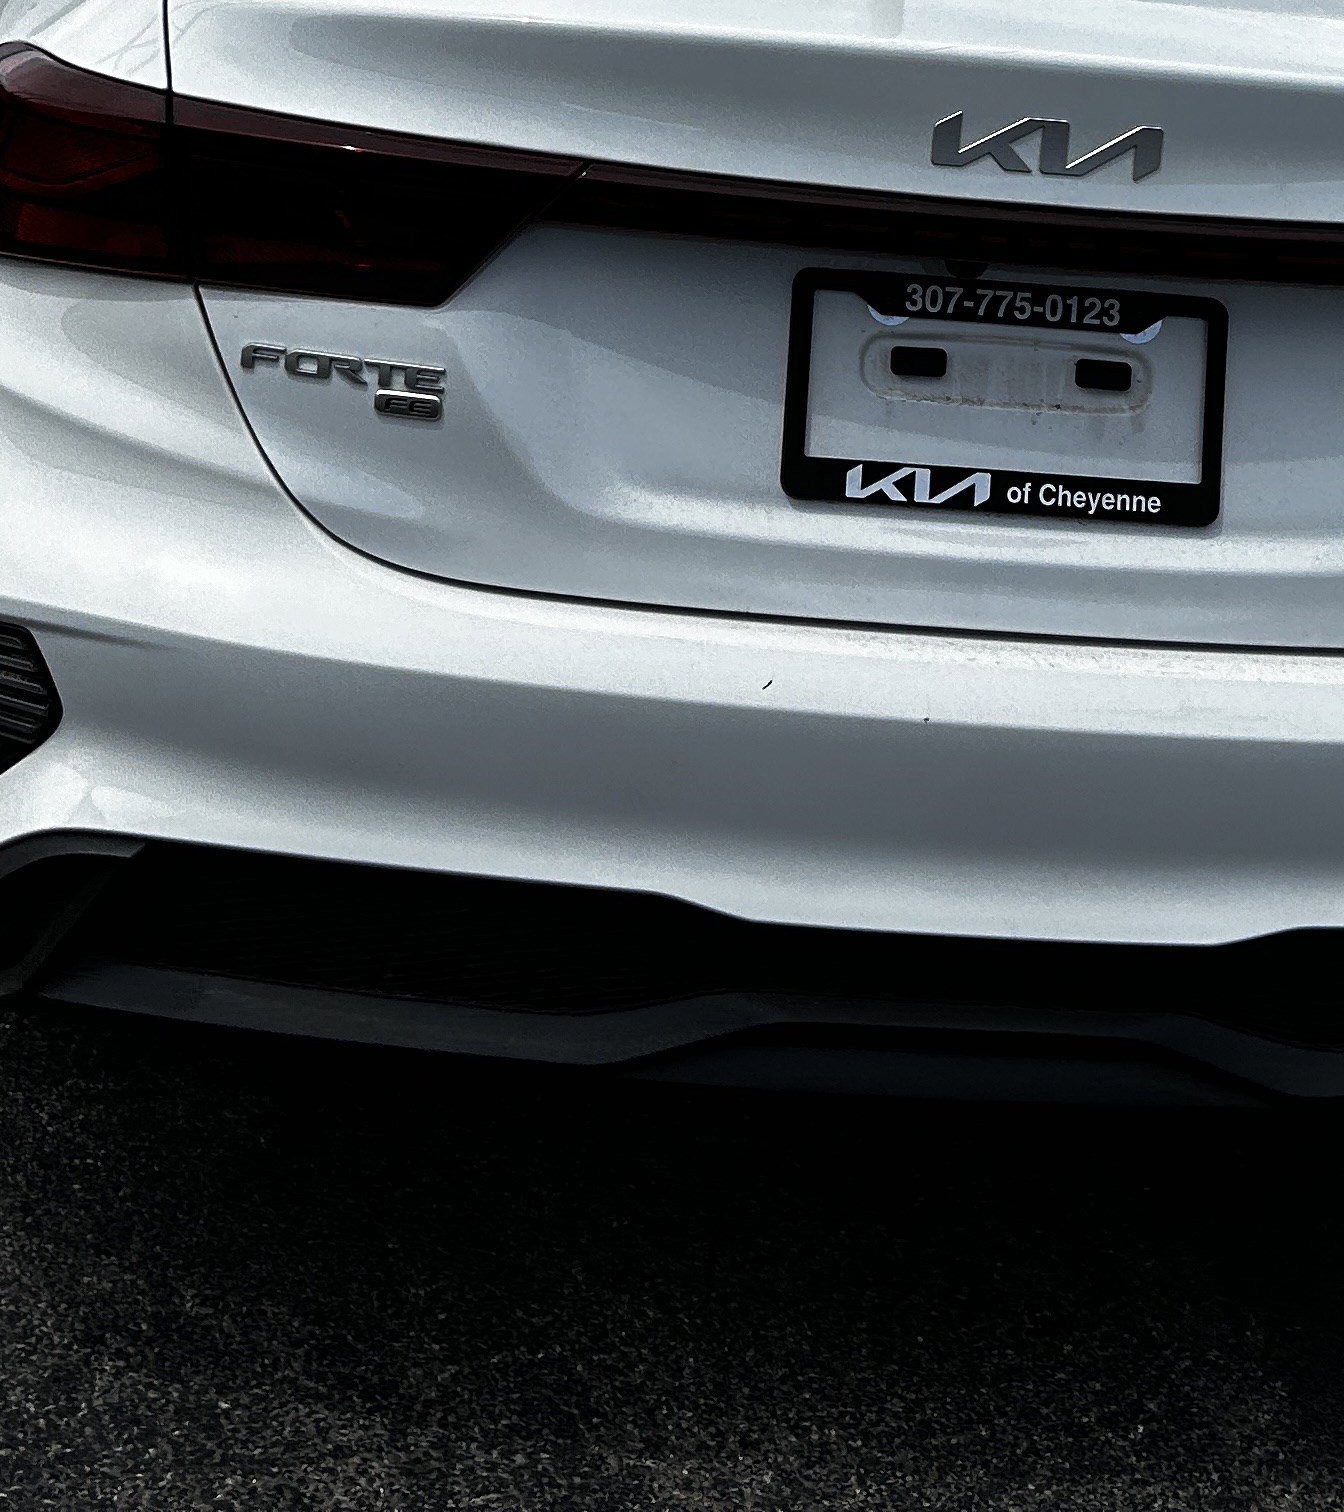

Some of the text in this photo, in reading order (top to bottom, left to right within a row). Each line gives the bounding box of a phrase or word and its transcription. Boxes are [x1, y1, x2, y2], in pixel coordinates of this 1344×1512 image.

[931, 110, 1164, 182] KIA
[906, 283, 1121, 326] 307-775-0123
[240, 341, 446, 394] FORTE
[846, 464, 1162, 514] KIA of Cheyenne
